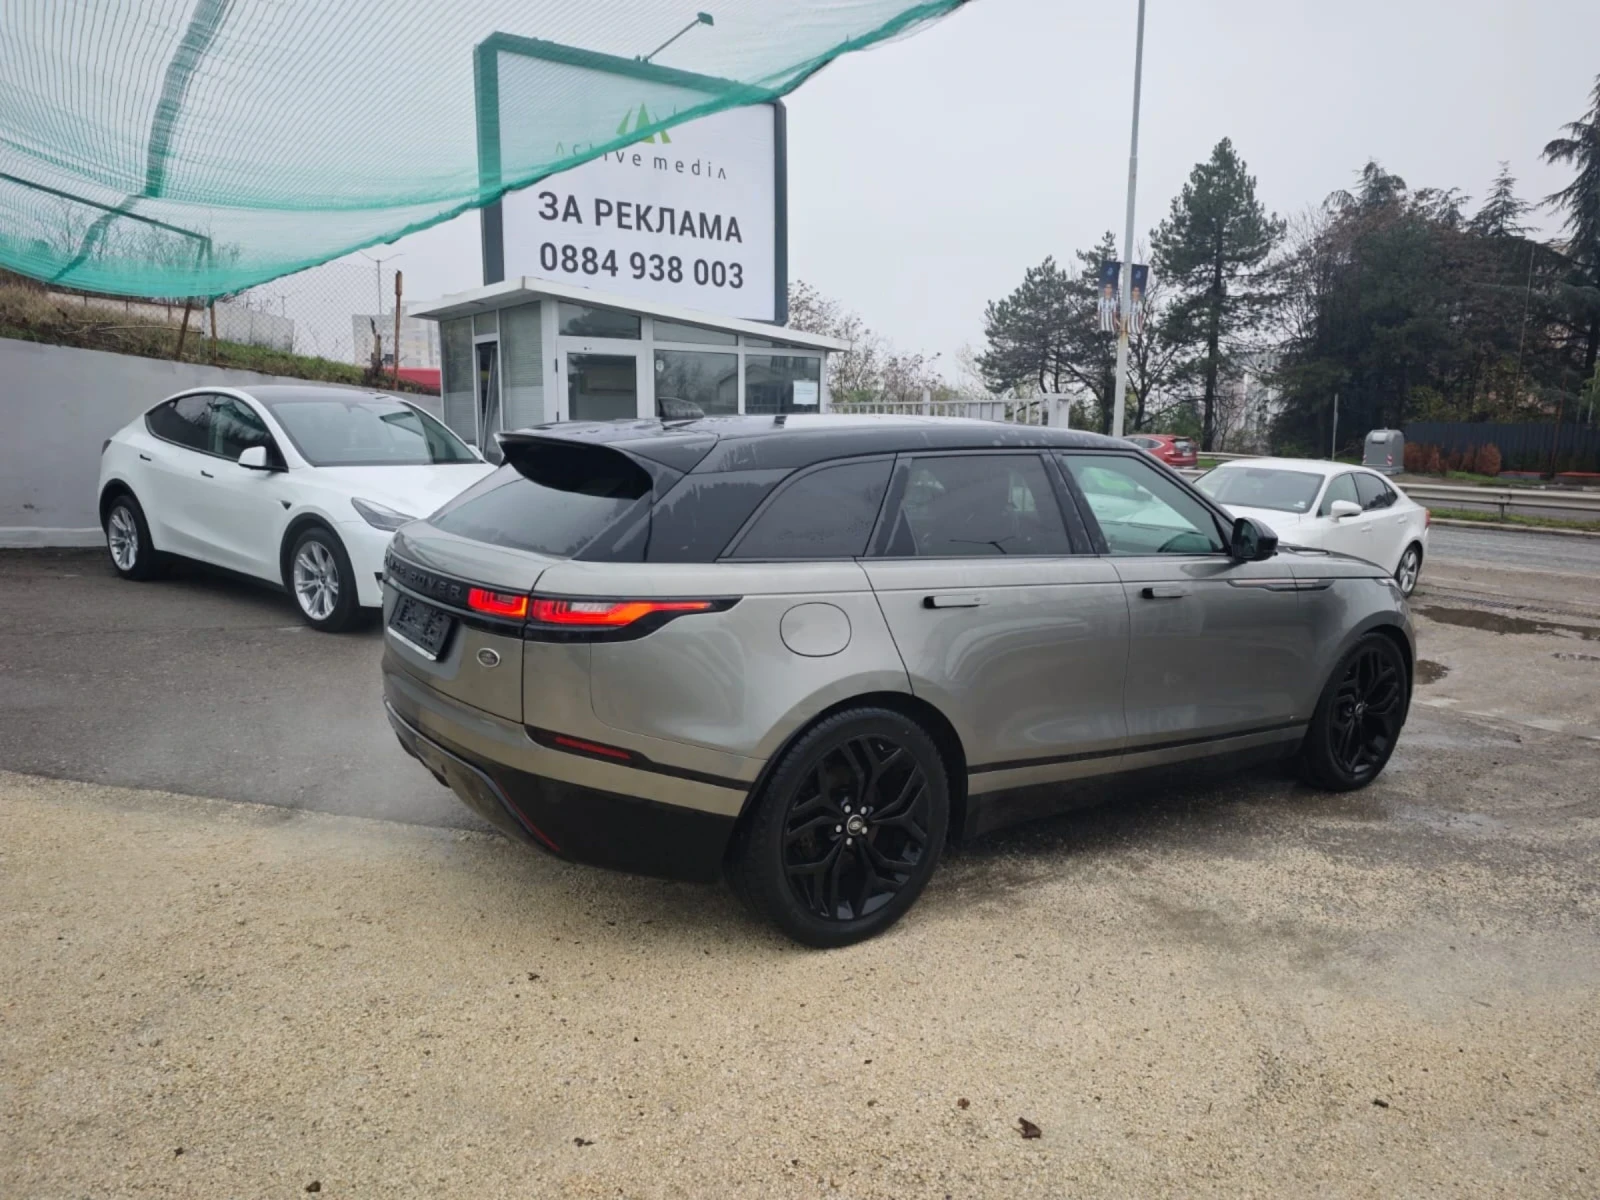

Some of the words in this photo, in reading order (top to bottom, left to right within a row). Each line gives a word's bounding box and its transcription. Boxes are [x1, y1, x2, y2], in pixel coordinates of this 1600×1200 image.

[538, 191, 583, 224] ЗА
[594, 198, 743, 243] РЕКЛАМА
[539, 242, 619, 277] 0884
[629, 251, 683, 283] 938
[693, 258, 743, 289] 003
